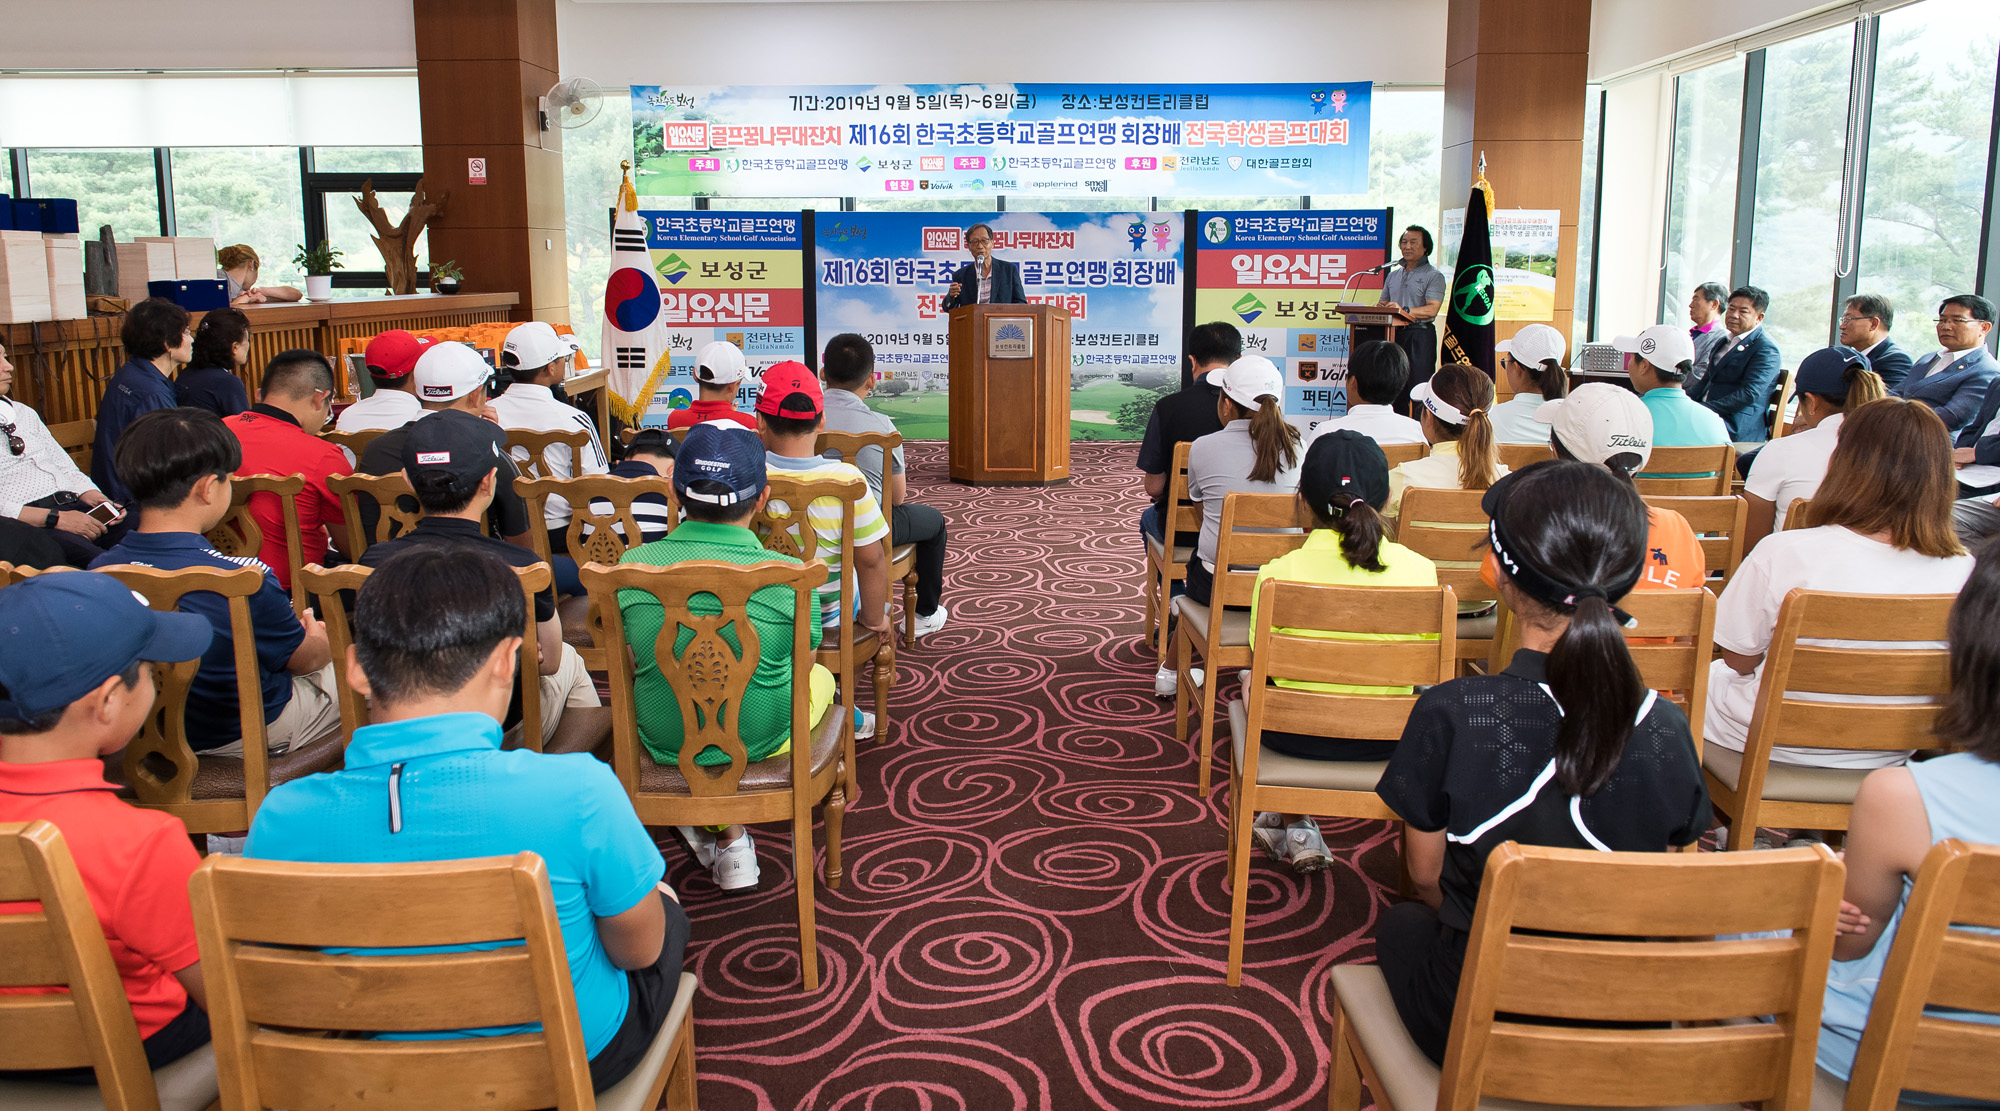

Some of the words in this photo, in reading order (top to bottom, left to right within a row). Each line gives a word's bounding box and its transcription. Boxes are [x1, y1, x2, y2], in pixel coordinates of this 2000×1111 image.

[788, 95, 880, 111] 기간:2019년
[885, 94, 910, 110] 9월
[916, 93, 1037, 110] 5일(목)~6일(금)
[1061, 93, 1209, 110] 장소:보성컨트리클럽
[668, 125, 704, 146] 일요신문
[711, 125, 842, 147] 골프꿈나무대잔치
[848, 123, 911, 146] 제16회
[915, 122, 1117, 146] 한국초등학교골프연맹
[1121, 122, 1181, 145] 회장배
[1186, 120, 1348, 146] 전국학생골프대회
[694, 160, 715, 170] 주최
[741, 158, 849, 171] 한국초등학교골프연맹
[877, 159, 913, 170] 보성군
[959, 157, 980, 169] 주관
[1008, 157, 1117, 170] 한국초등학교골프연맹
[1130, 158, 1151, 169] 후원
[1179, 156, 1220, 166] 전라남도
[1246, 158, 1312, 169] 대한골프협회
[655, 217, 796, 234] 한국초등학교골프연맹
[1234, 217, 1379, 233] 한국초등학교골프연맹
[679, 234, 718, 243] Elementary
[719, 234, 742, 242] School
[743, 234, 758, 242] Golf
[759, 234, 797, 242] Association
[926, 231, 958, 248] 일요신문
[963, 231, 1075, 249] 꿈나무대잔치
[1235, 234, 1256, 242] Korea
[1257, 234, 1297, 243] Elementary
[1297, 234, 1321, 242] School
[1321, 234, 1338, 242] Golf
[1338, 234, 1378, 242] Association
[700, 261, 768, 280] 보성군
[822, 260, 890, 285] 제16회
[894, 259, 1107, 285] 한국초골프연맹
[1111, 260, 1176, 285] 회장배
[1231, 254, 1348, 285] 일요신문
[663, 292, 770, 323] 일요신문
[671, 332, 693, 351] 보성
[745, 332, 795, 343] 전라남도
[913, 333, 933, 345] 9월
[1071, 333, 1159, 346] :보성컨트리클럽
[1246, 331, 1268, 351] 보성
[1085, 354, 1177, 365] 한국초등학교골프연맹
[424, 386, 452, 396] Titleist
[1302, 389, 1347, 407] 퍼티스
[1424, 397, 1438, 413] Max
[419, 454, 446, 463] Titleist
[701, 465, 722, 473] GOLF
